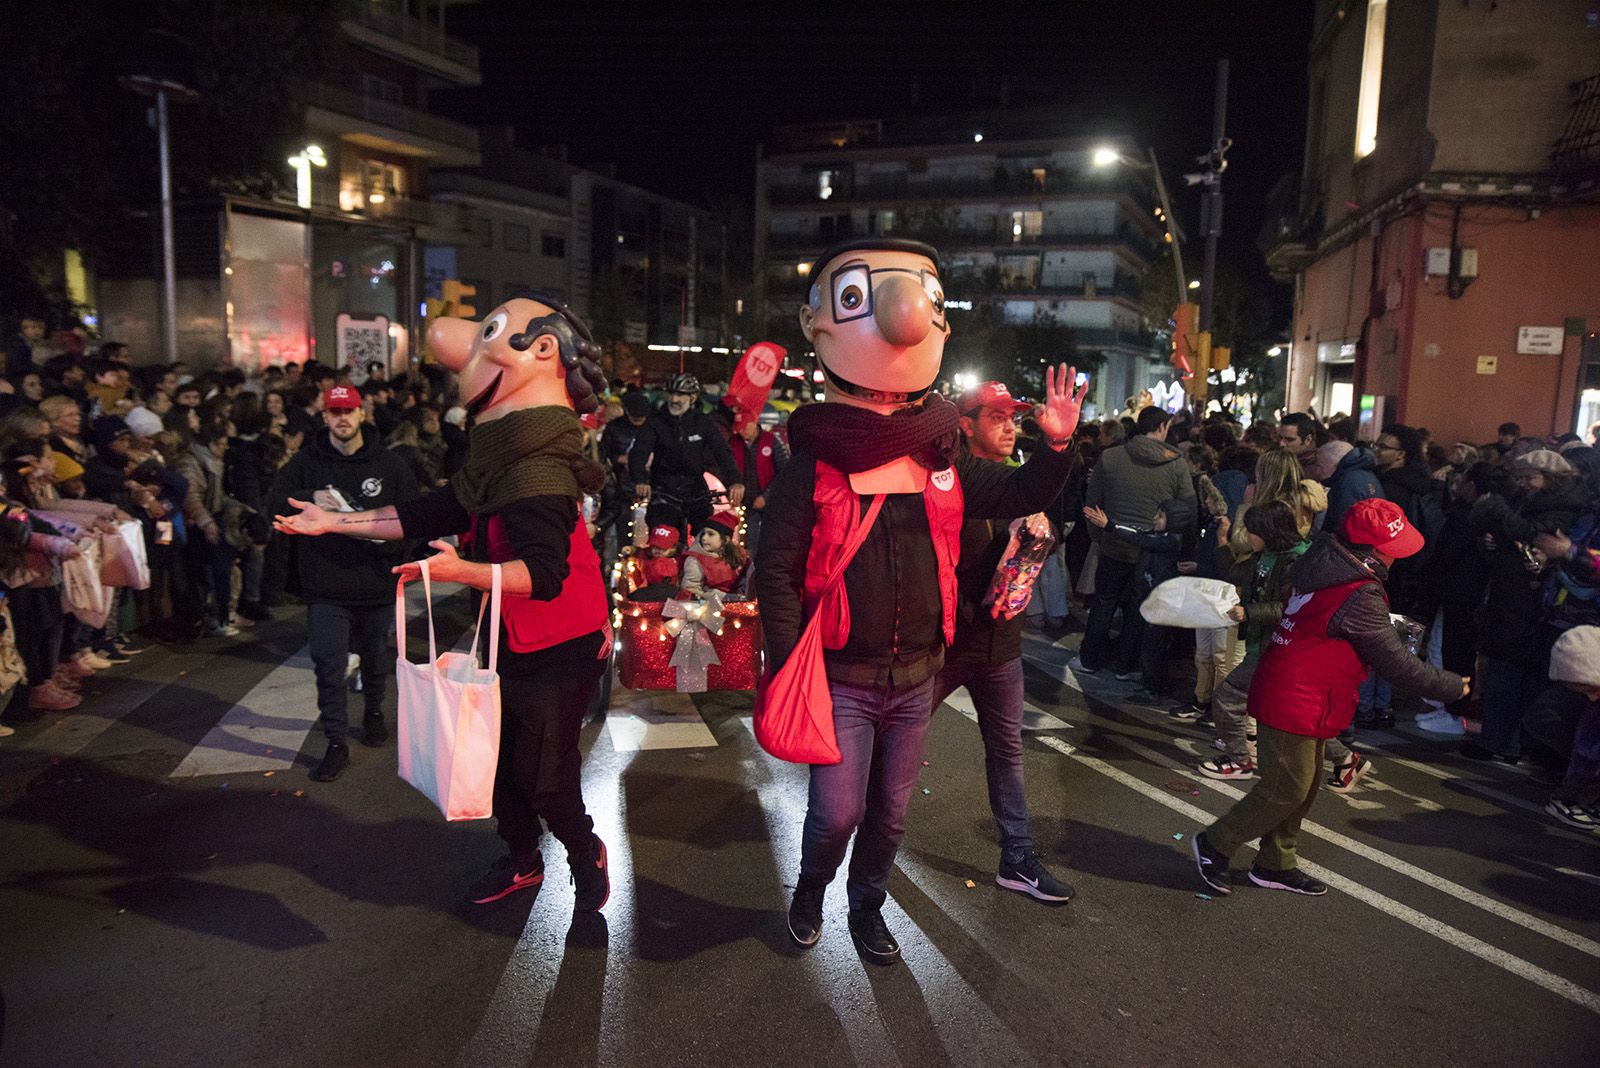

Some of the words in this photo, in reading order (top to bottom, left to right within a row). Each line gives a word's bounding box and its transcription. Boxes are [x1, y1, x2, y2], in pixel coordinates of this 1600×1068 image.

[752, 356, 773, 376] TOT
[991, 383, 1007, 392] TO
[935, 472, 951, 484] TOT
[655, 528, 671, 537] TOT
